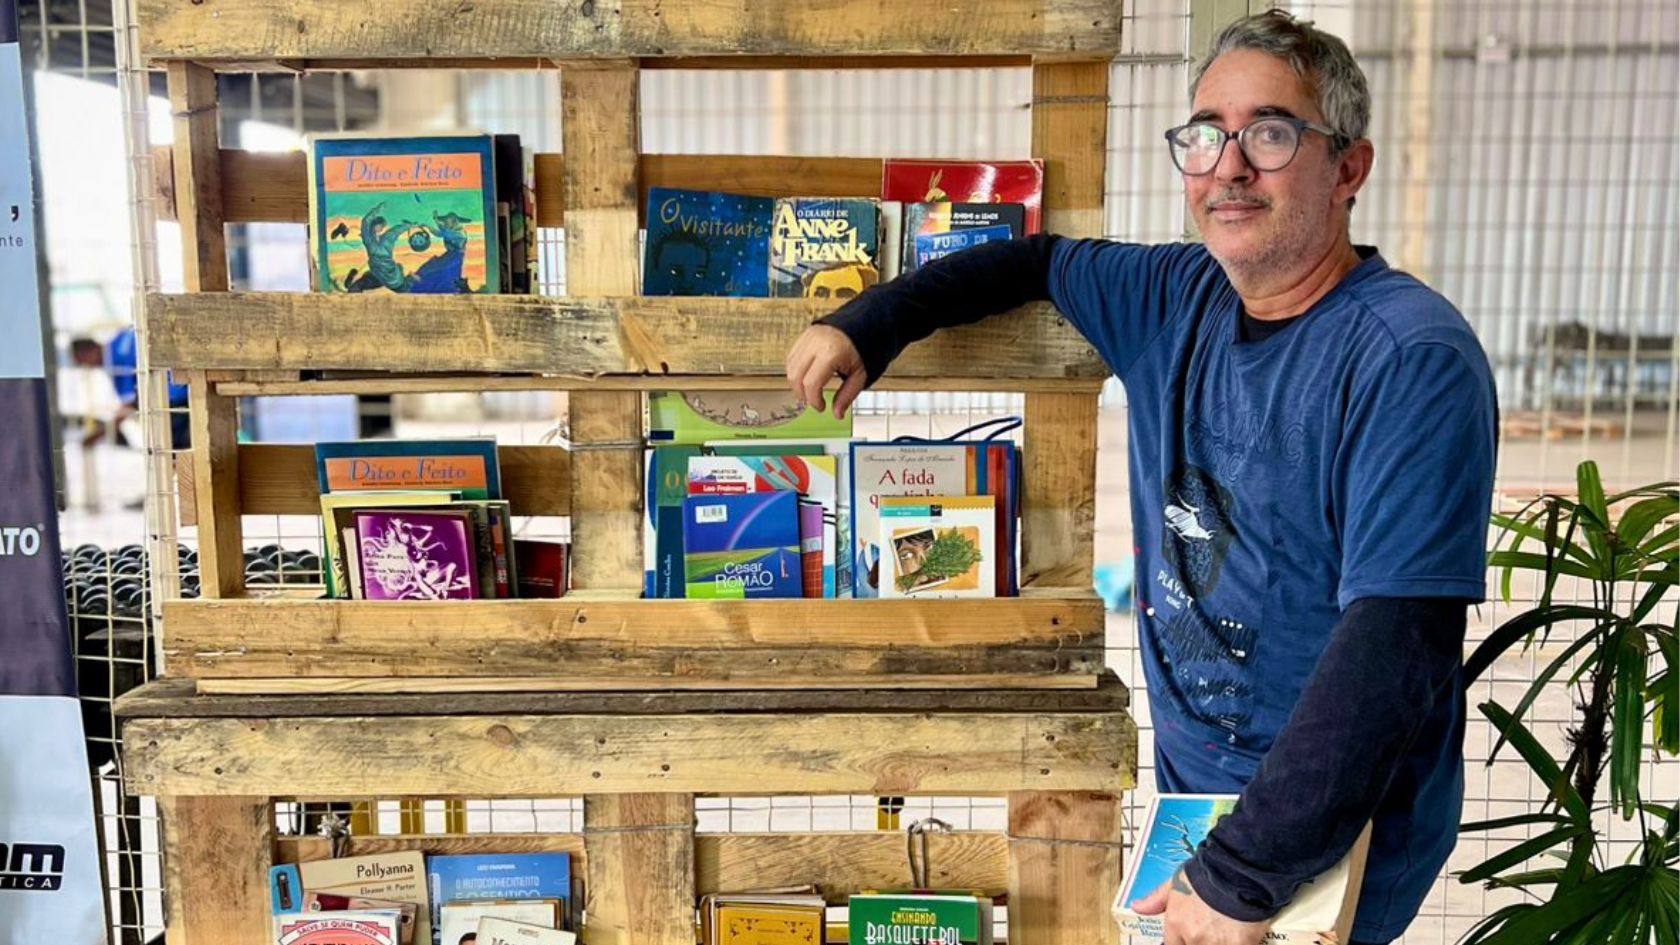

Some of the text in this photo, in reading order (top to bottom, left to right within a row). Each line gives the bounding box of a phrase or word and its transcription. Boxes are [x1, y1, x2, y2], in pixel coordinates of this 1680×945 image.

[346, 157, 463, 182] Dito e Feito
[660, 198, 764, 238] O Visitante
[796, 205, 804, 217] O
[836, 204, 848, 217] DE
[350, 457, 467, 482] Dito e Feito
[879, 468, 935, 486] A fada
[724, 561, 764, 575] Cesar
[715, 570, 774, 589] ROMÃO
[357, 862, 414, 879] Pollyanna
[891, 910, 937, 925] ENSINANDO
[864, 921, 963, 945] BASQUETEBOL
